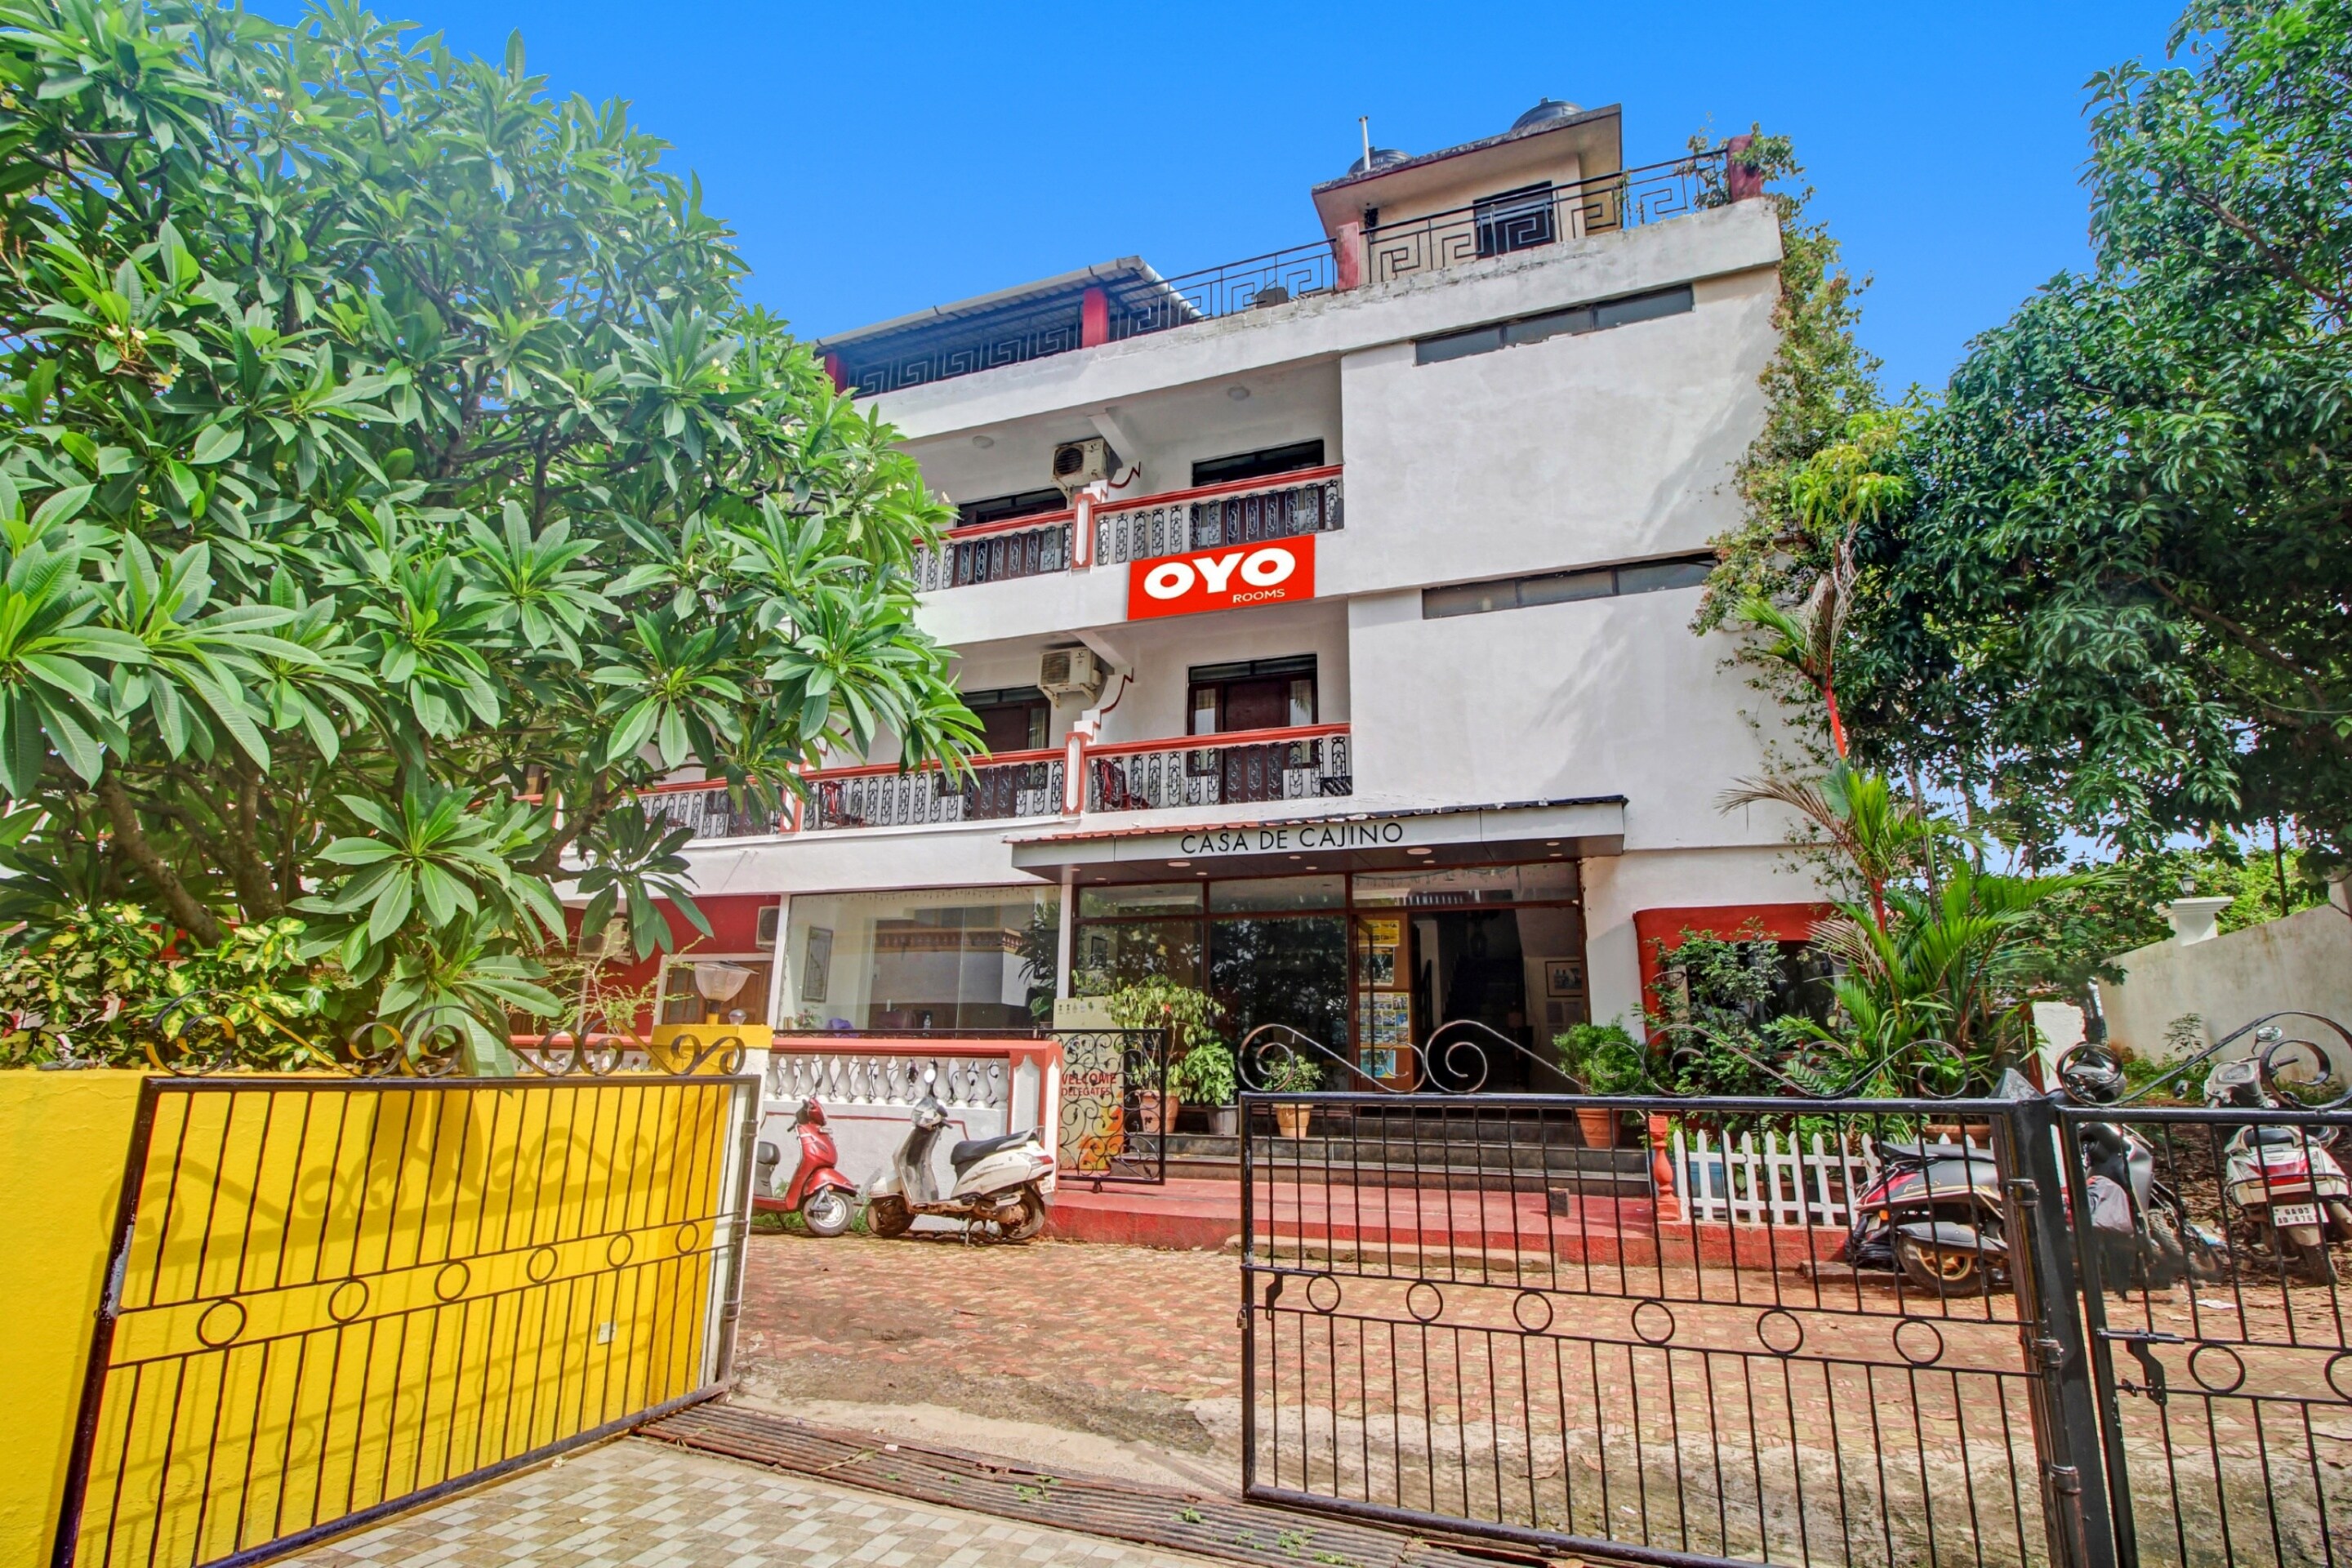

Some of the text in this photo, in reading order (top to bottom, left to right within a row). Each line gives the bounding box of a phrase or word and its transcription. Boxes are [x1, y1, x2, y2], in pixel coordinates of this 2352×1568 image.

[1144, 547, 1295, 599] OYO
[1232, 589, 1285, 603] ROOMS
[1181, 822, 1403, 854] CASA DE CAJINO
